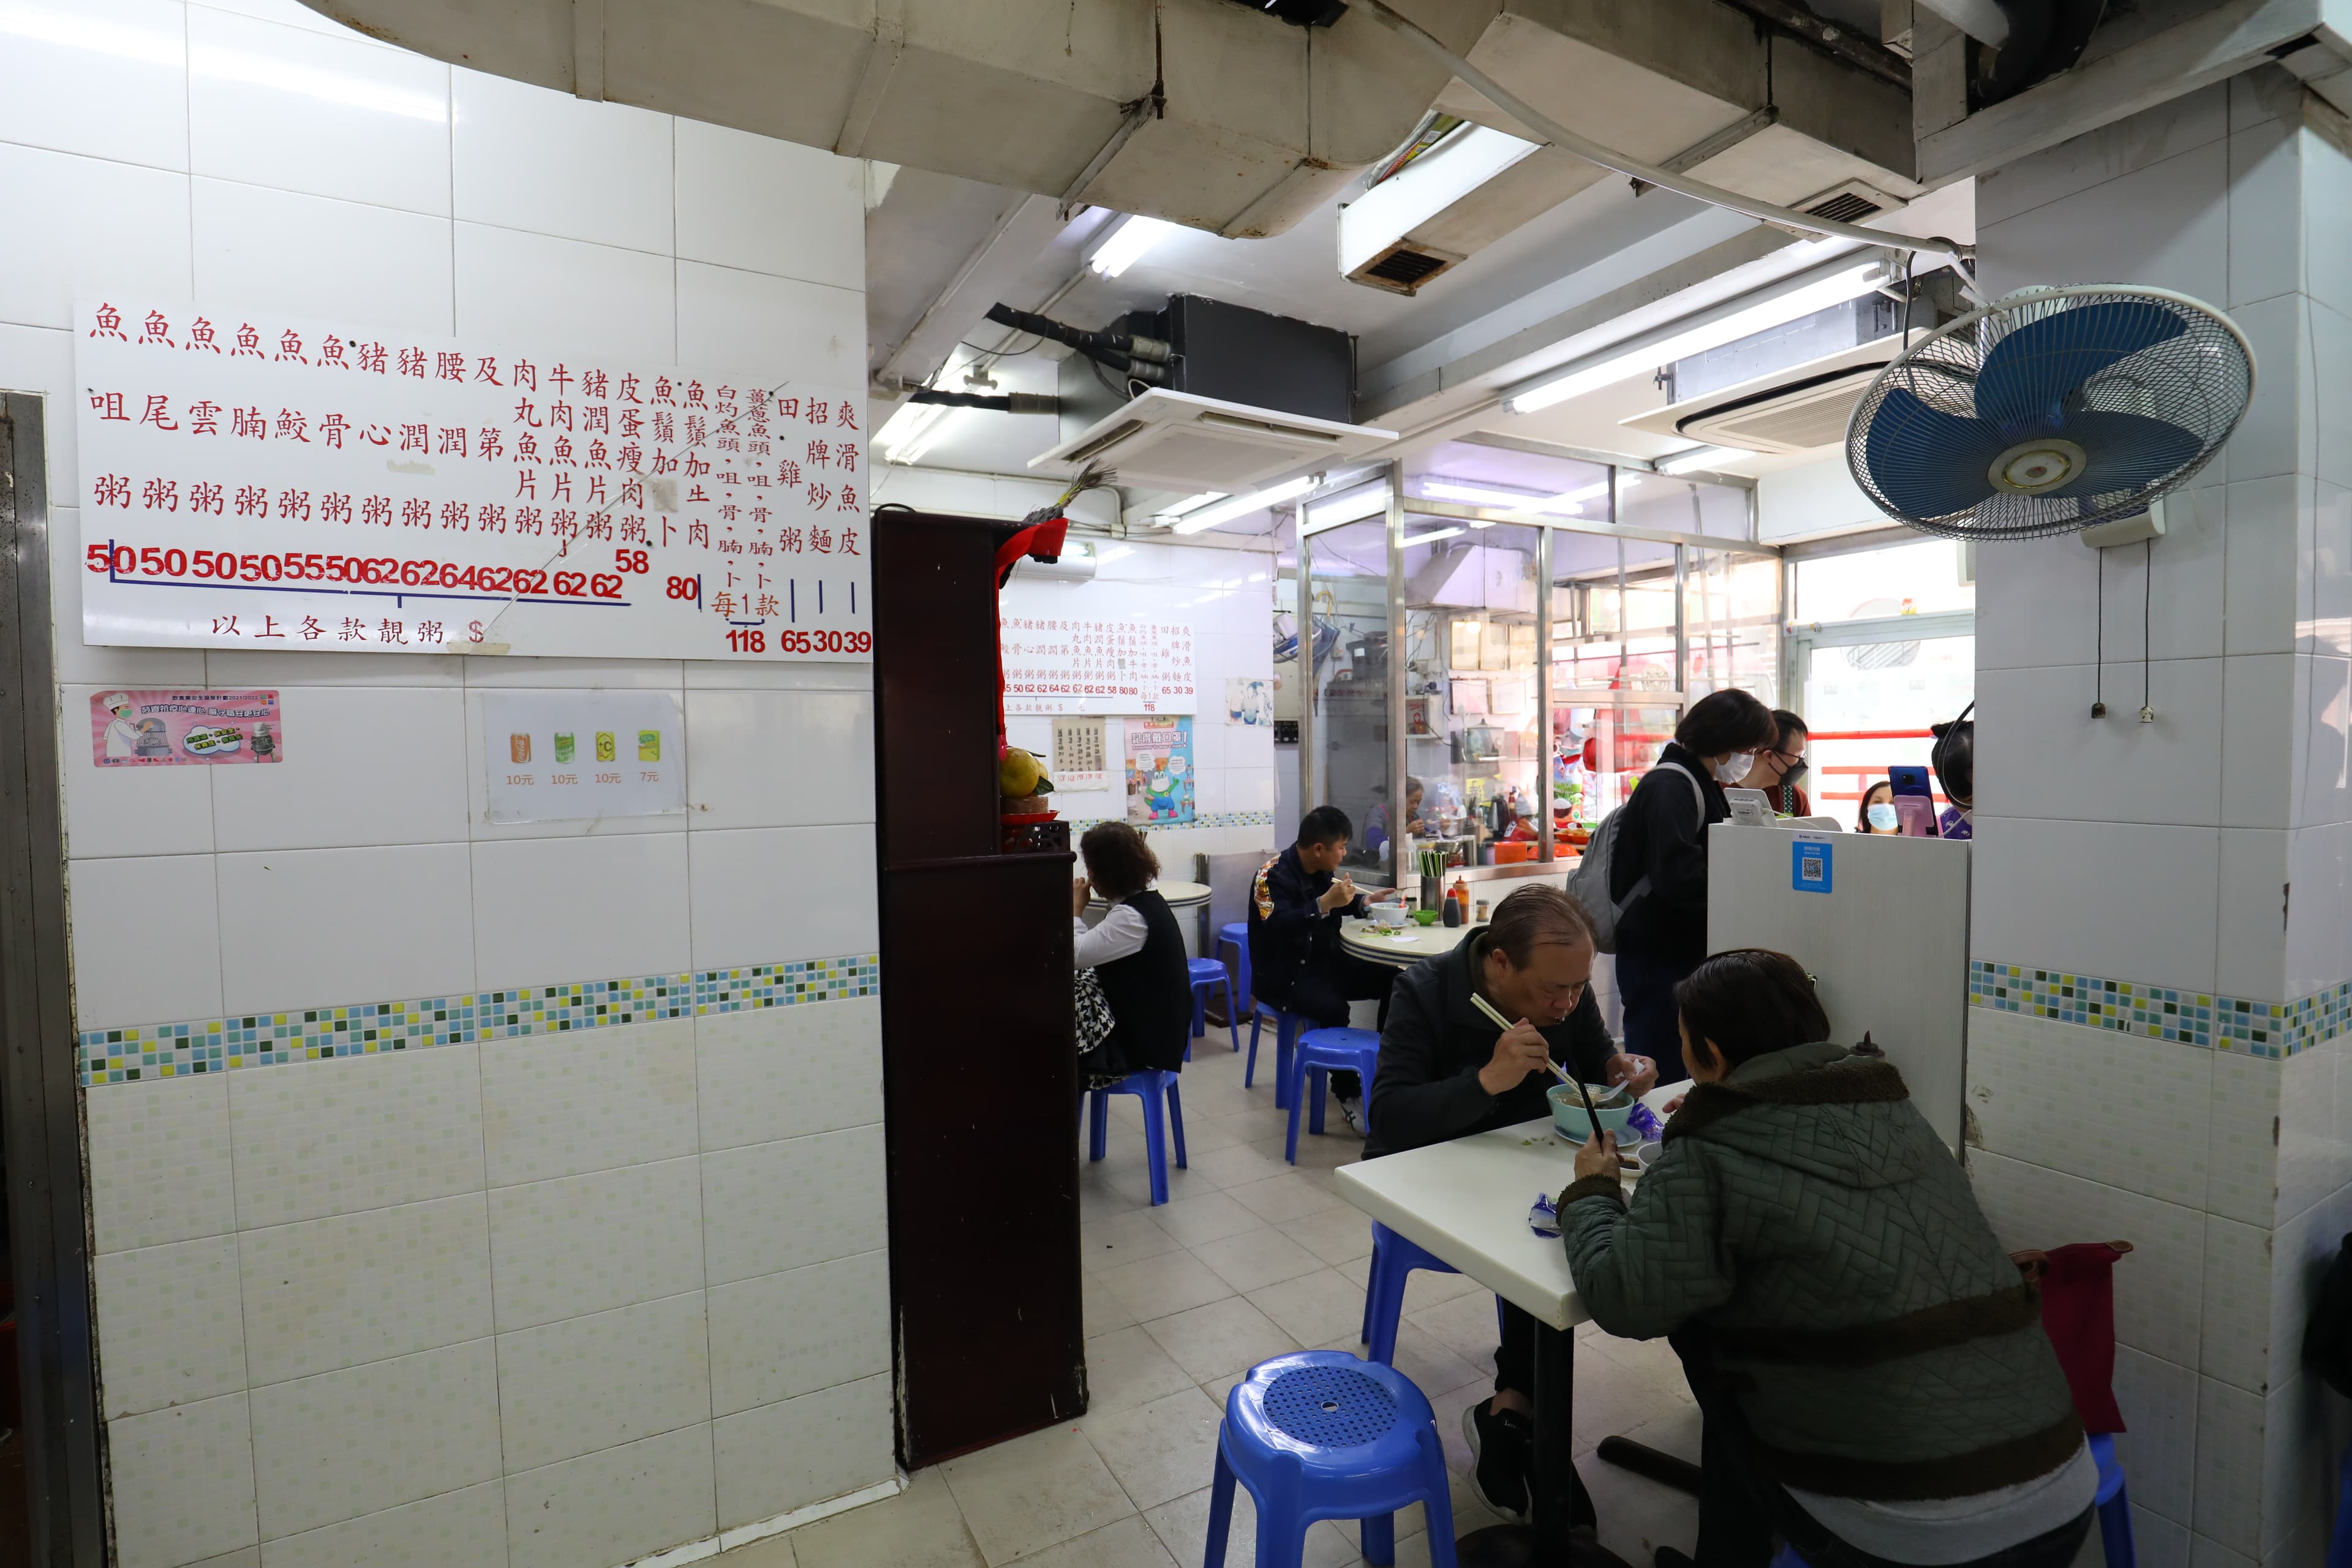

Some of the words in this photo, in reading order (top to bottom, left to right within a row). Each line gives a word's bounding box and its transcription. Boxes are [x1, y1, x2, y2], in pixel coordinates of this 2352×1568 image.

[89, 302, 132, 509] 魚咀粥
[138, 309, 179, 513] 魚尾粥
[185, 316, 224, 516] 魚雲粥
[230, 323, 269, 519] 魚腩粥
[317, 334, 353, 525] 魚骨粥
[358, 341, 393, 527] 豬心粥
[399, 345, 432, 530] 豬潤粥
[437, 352, 470, 532] 腰潤粥
[475, 356, 507, 534] 及第粥
[513, 358, 545, 537] 肉丸魚片粥
[548, 363, 578, 538] 牛肉魚片粥
[582, 368, 613, 542] 豬潤魚片粥
[617, 372, 646, 544] 皮蛋瘦肉粥
[650, 375, 679, 547] 魚鬚加卜
[777, 398, 803, 554] 田雞粥
[805, 396, 832, 554] 招牌炒麵
[836, 401, 861, 556] 爽滑魚皮
[86, 544, 137, 575] 50
[140, 547, 187, 577] 50
[192, 550, 238, 580] 50
[239, 554, 282, 582] 50
[284, 552, 325, 581] 55
[326, 555, 363, 583] 50
[363, 558, 400, 584] 62
[400, 560, 440, 586] 62
[439, 563, 478, 590] 64
[477, 567, 513, 592] 62
[513, 568, 548, 594] 62
[553, 571, 587, 597] 62
[590, 573, 623, 600] 62
[211, 614, 444, 646] 以上各款靚粥
[468, 619, 484, 643] $
[615, 549, 649, 575] 58
[666, 576, 698, 601] 80
[725, 629, 766, 653] 118
[780, 630, 812, 654] 65
[812, 630, 843, 653] 30
[843, 631, 872, 654] 39
[1060, 684, 1070, 693] 62
[1084, 685, 1094, 693] 62
[1162, 686, 1171, 695] 65
[506, 774, 534, 785] 10元
[551, 774, 578, 785] 10元
[595, 773, 621, 784] 10元
[640, 771, 659, 782] 7元
